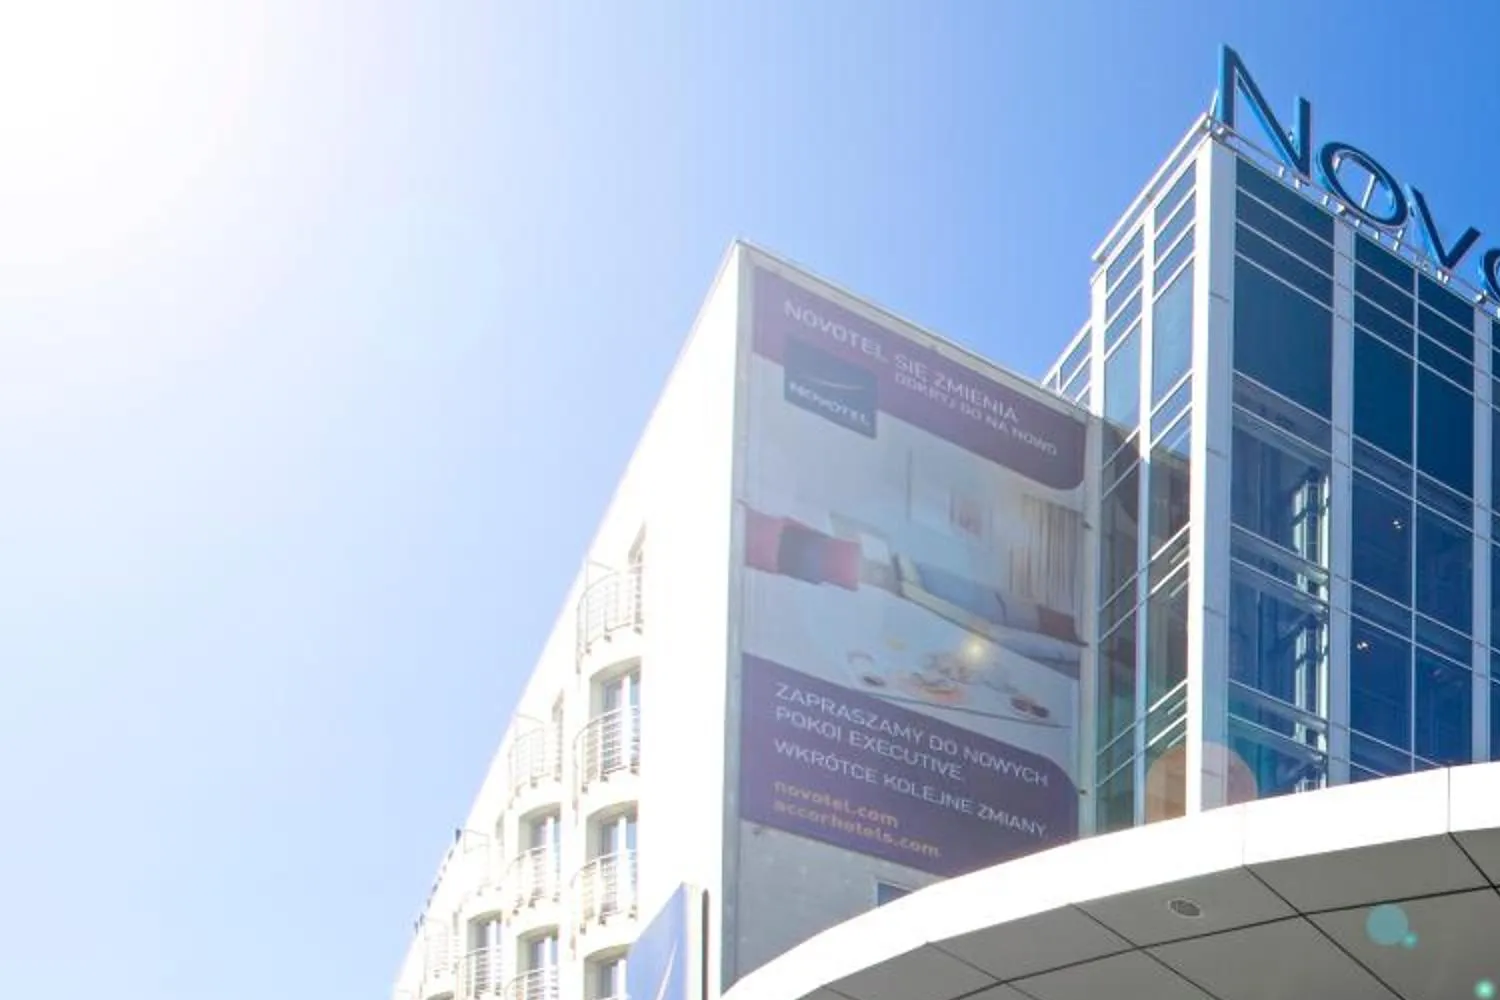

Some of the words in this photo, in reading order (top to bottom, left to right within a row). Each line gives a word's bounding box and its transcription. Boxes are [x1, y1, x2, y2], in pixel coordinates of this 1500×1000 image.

[784, 300, 889, 364] NOVOTEL
[934, 372, 1019, 425] ZMIENIA
[775, 682, 925, 745] ZAPRASZAMY
[929, 735, 958, 756] DO
[963, 746, 1049, 787] NOWYCH
[776, 705, 842, 742] POKOI
[774, 738, 880, 784] WKRÓTCE
[883, 773, 974, 815] KOLEJNE
[977, 804, 1048, 838] ZMIANY
[774, 780, 899, 829] novotel.com
[773, 800, 942, 859] accorhotels.com
